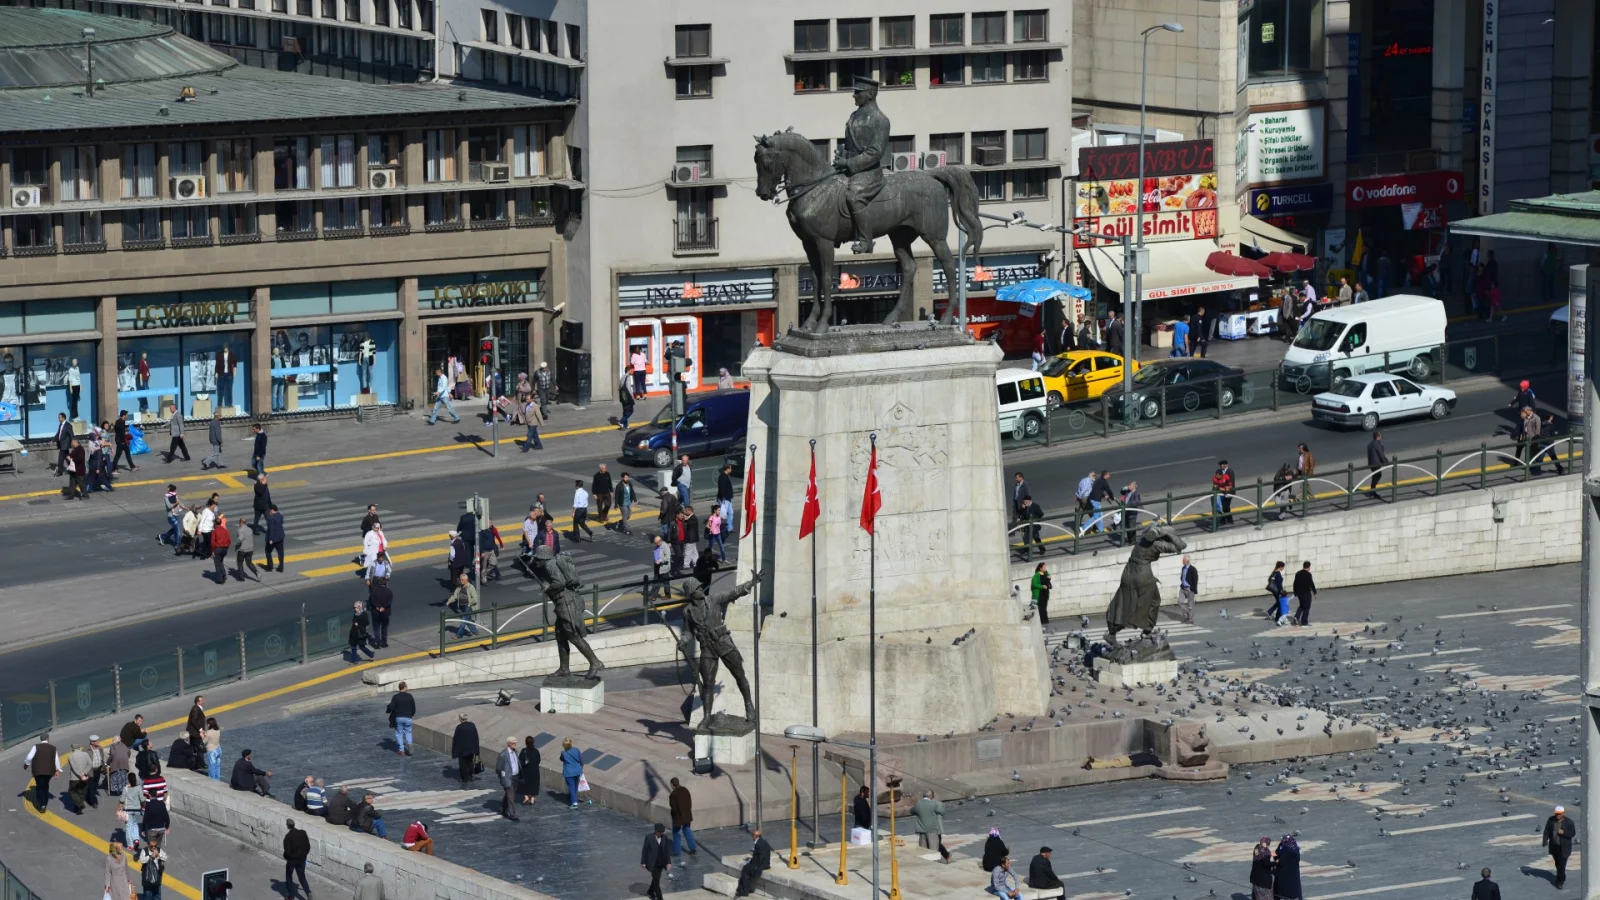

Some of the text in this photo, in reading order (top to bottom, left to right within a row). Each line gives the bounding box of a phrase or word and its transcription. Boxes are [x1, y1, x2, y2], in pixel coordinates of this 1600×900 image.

[1483, 2, 1494, 90] ŞEHİR
[1264, 116, 1287, 125] Baharat
[1281, 134, 1302, 143] bitkiler
[1264, 144, 1309, 155] Yöresel ürünler
[1083, 145, 1213, 178] İSTANBUL
[1264, 154, 1313, 165] Organik ürünler
[1295, 163, 1318, 172] ürünleri
[1366, 184, 1416, 199] vodafone
[1272, 193, 1312, 206] TURKCELL
[1103, 212, 1190, 245] gül simit
[434, 285, 457, 301] LC
[646, 282, 755, 300] ING BANK
[1148, 289, 1168, 298] GÜL
[135, 304, 160, 321] LC
[482, 341, 492, 350] 26
